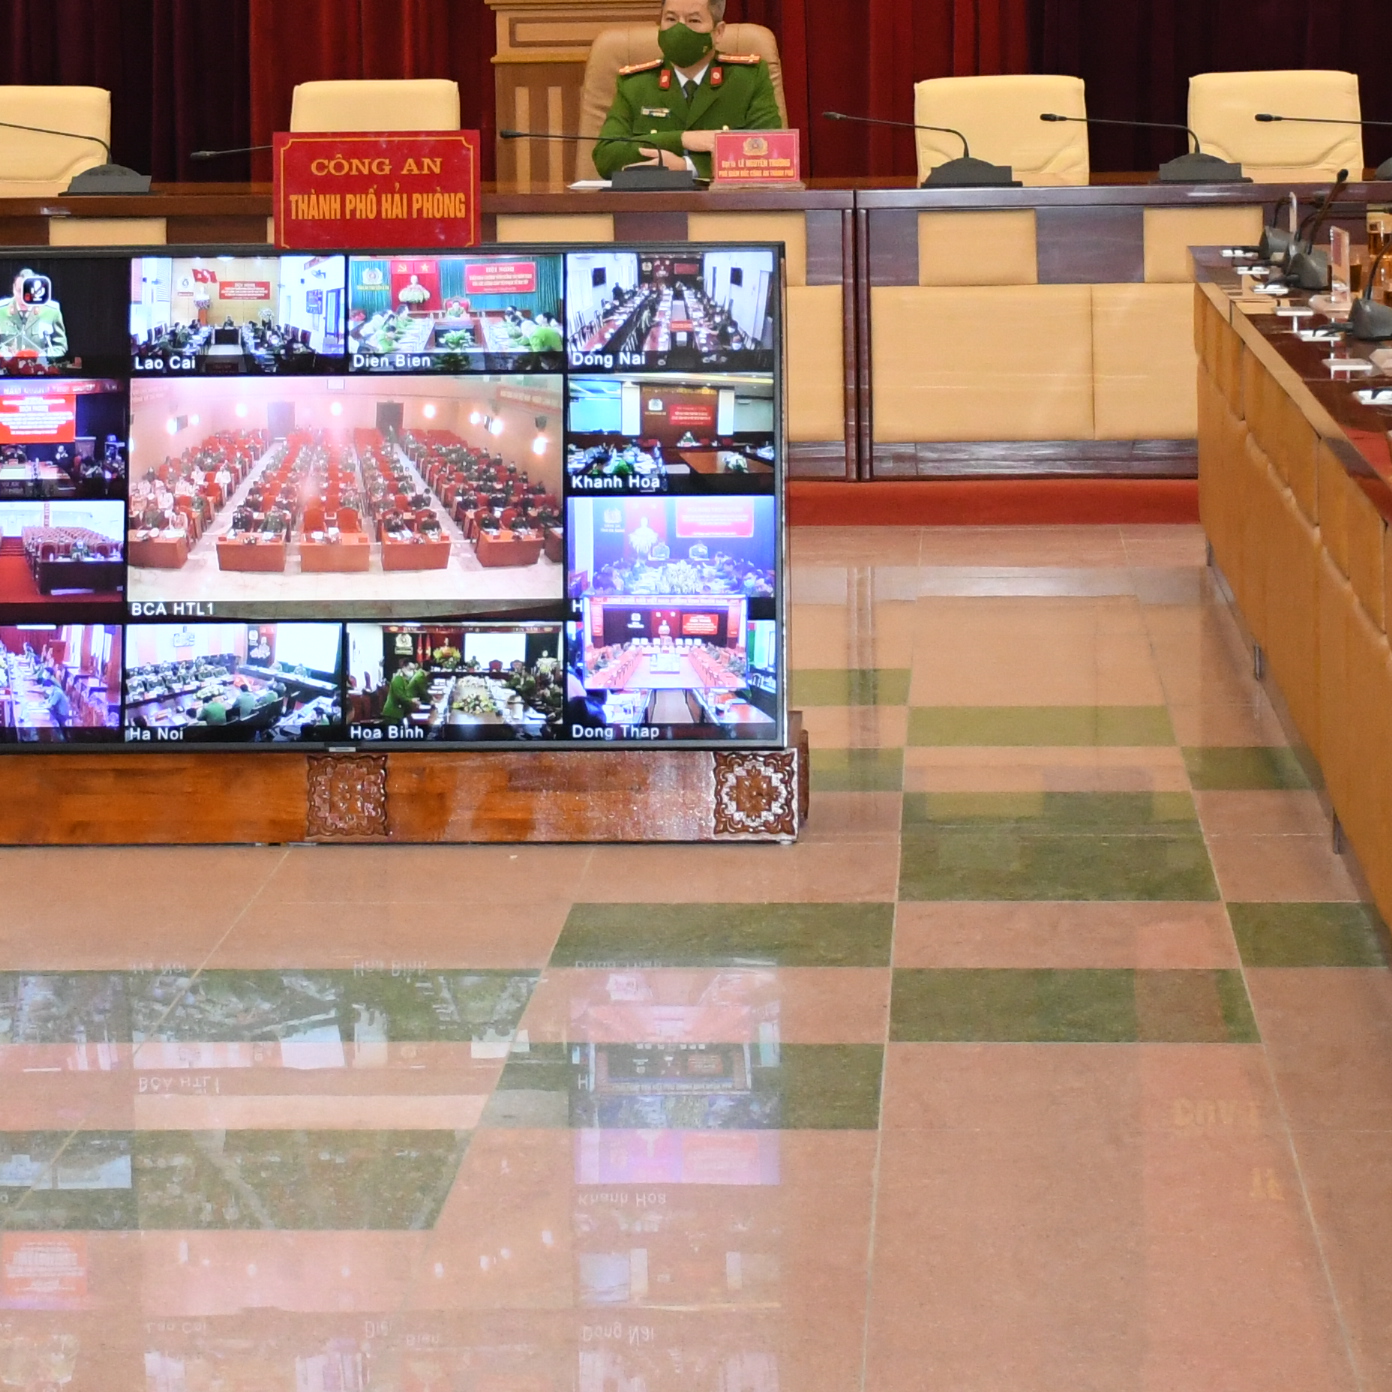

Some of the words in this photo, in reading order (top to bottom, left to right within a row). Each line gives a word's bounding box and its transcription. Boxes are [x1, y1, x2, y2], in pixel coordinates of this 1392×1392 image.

[310, 153, 393, 176] CÔNG
[400, 157, 443, 175] AN
[288, 188, 341, 220] THÀNH
[345, 184, 378, 220] PHỐ
[380, 183, 408, 220] HẢI
[411, 186, 466, 219] PHÒNG
[135, 356, 164, 370] Lao
[168, 356, 196, 370] Cai
[353, 353, 389, 368] Dien
[395, 353, 430, 368] Bien
[572, 352, 614, 369] Dong
[619, 352, 646, 366] Nai
[572, 475, 623, 489] Khanh
[629, 475, 660, 489] Hoa
[131, 602, 168, 617] BCA
[174, 602, 214, 617] HTL1
[130, 727, 153, 741] Ha
[158, 726, 184, 741] Noi
[350, 725, 382, 739] Hoa
[388, 725, 424, 739] Binh
[572, 725, 614, 741] Dong
[619, 724, 660, 741] Thap
